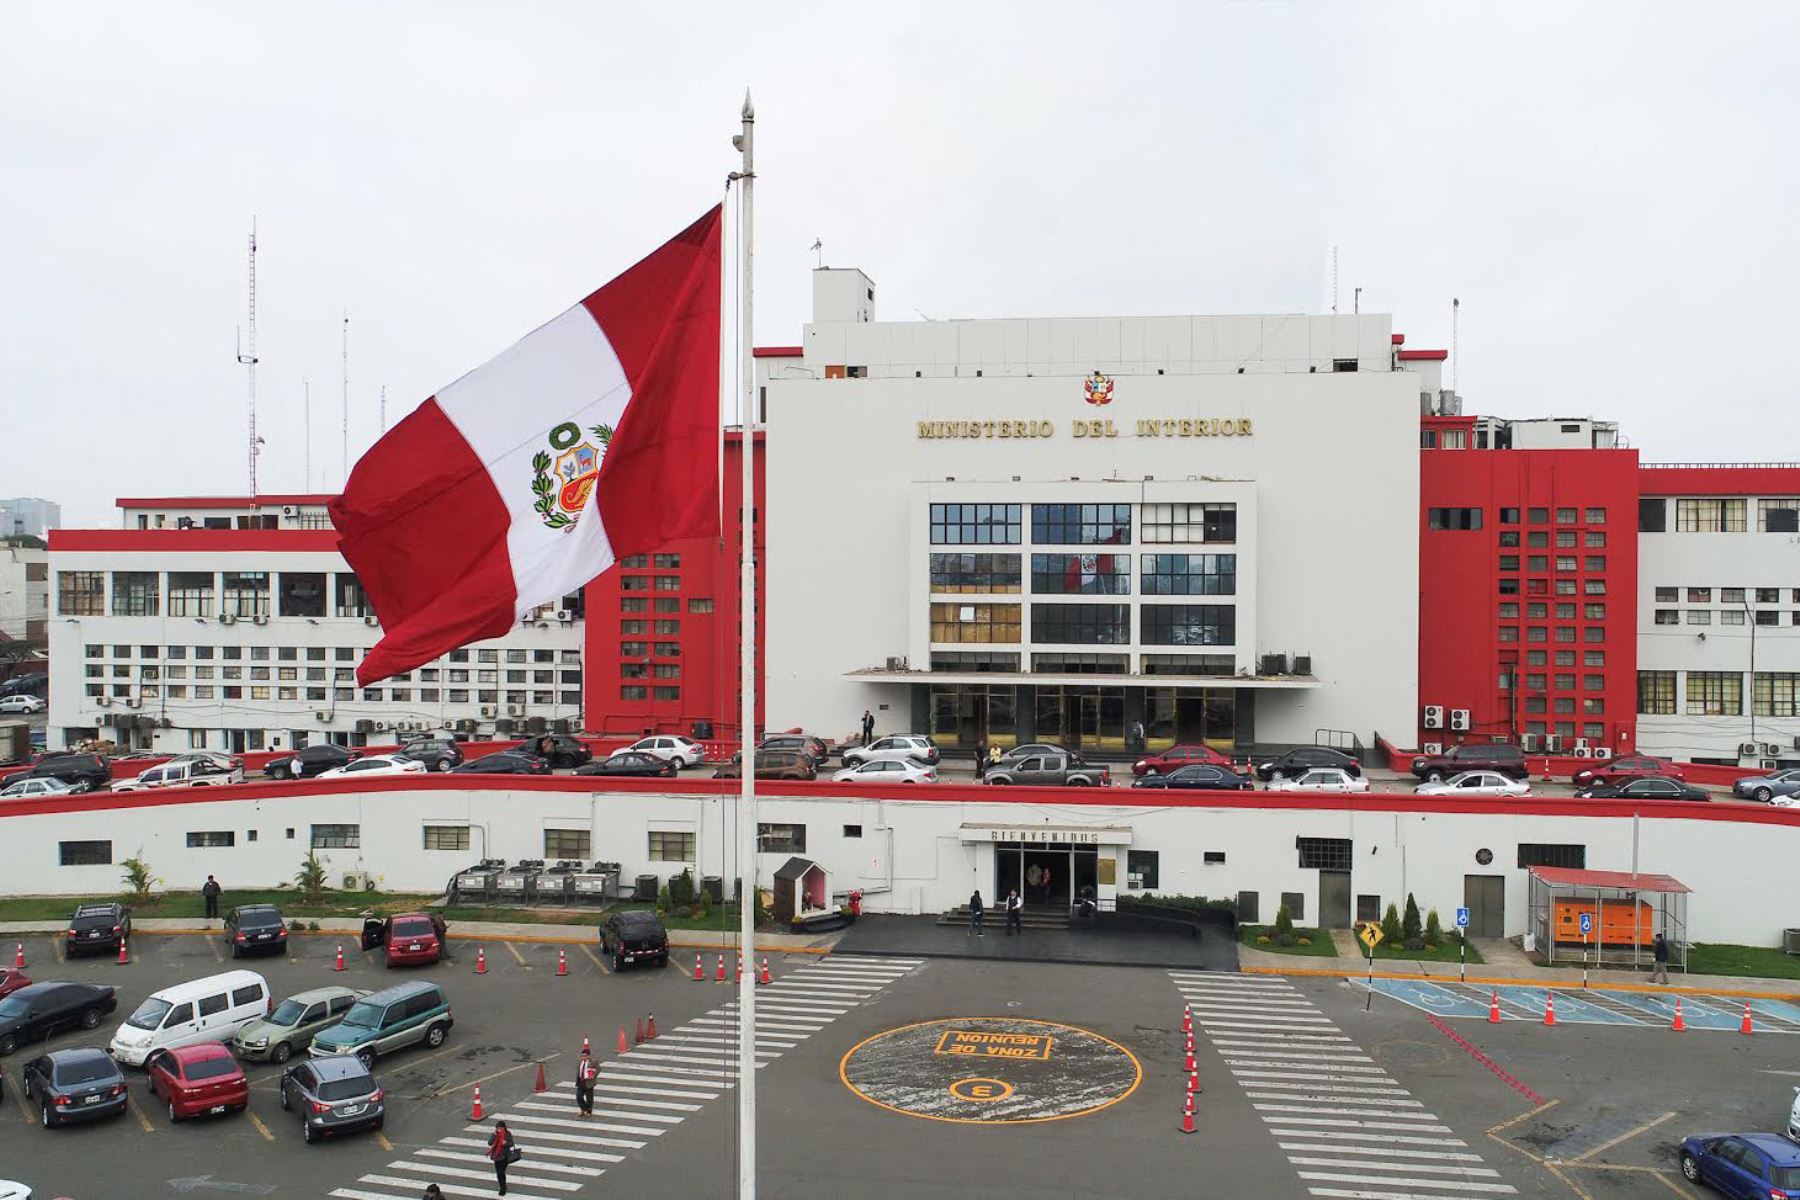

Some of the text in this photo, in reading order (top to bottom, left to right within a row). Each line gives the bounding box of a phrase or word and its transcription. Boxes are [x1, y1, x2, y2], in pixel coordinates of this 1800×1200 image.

[918, 418, 1254, 439] MINISTERIO DEL INTERIOR
[991, 831, 1098, 842] BIENVENIDOS
[956, 1034, 1039, 1045] REUNION
[949, 1045, 1038, 1056] ZONA DE
